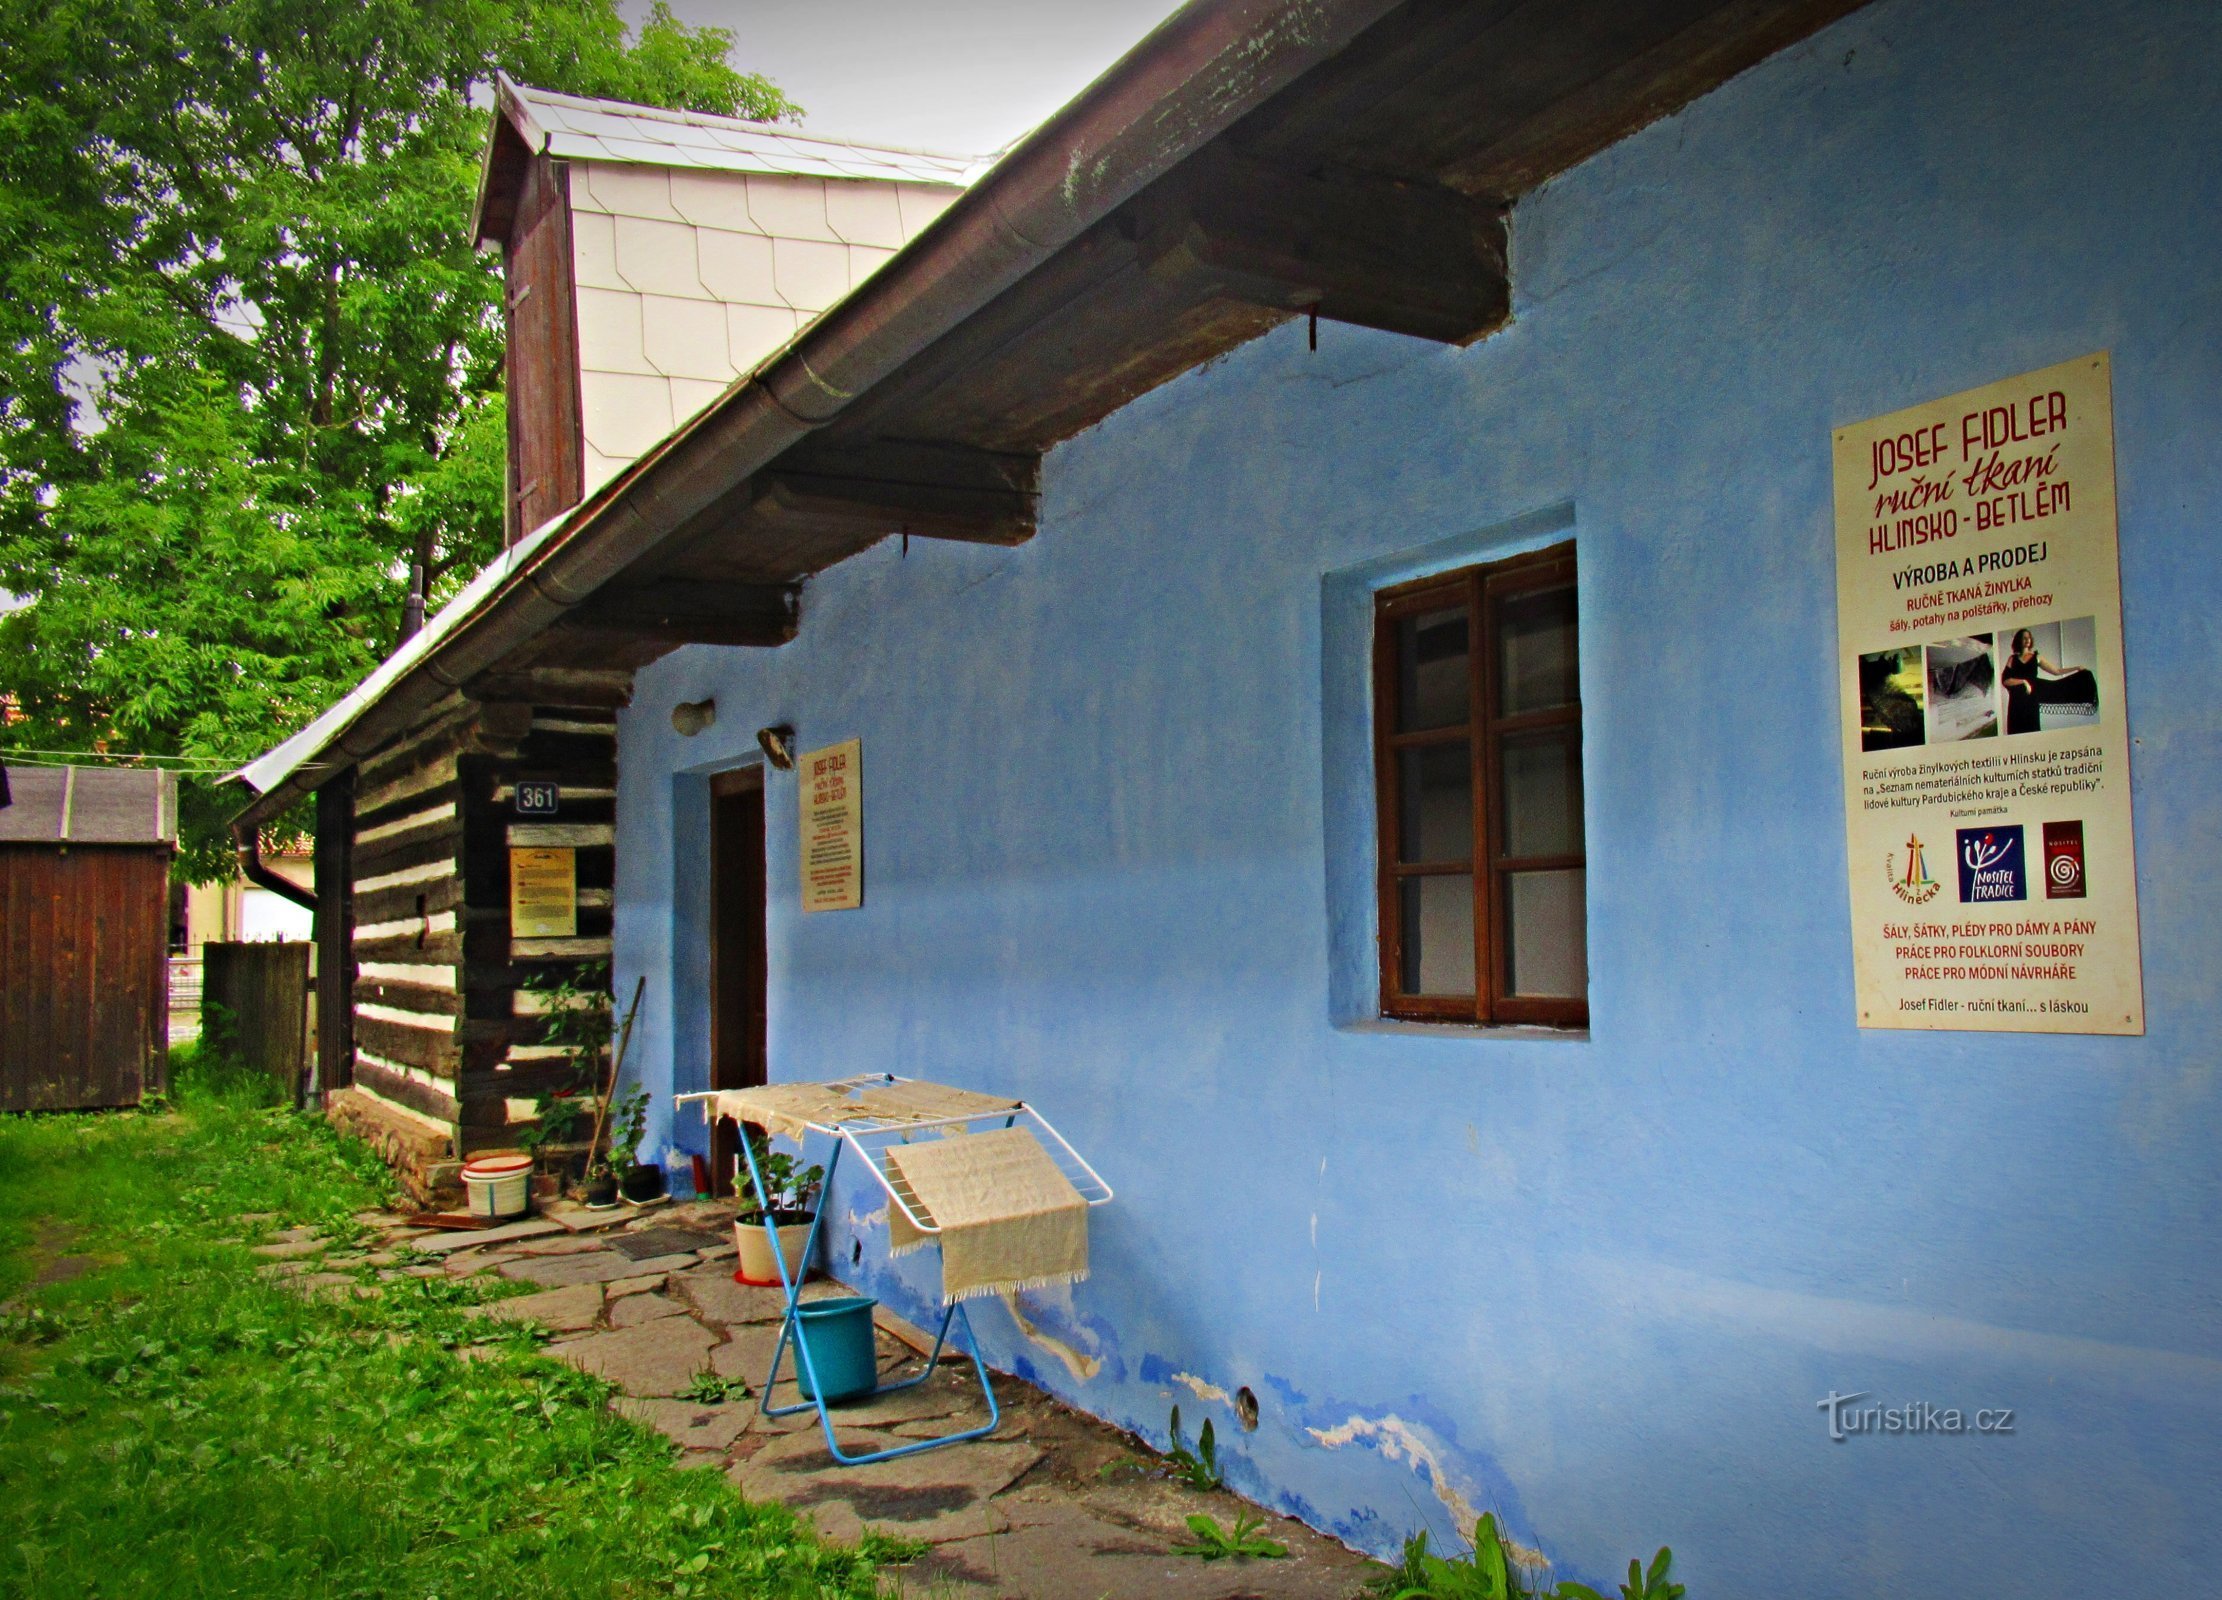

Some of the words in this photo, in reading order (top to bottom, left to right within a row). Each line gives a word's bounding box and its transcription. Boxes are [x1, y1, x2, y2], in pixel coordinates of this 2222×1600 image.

[1868, 422, 1948, 490] JOSEF
[1962, 391, 2066, 462] FIDLER
[1875, 469, 1956, 518] ruční
[1962, 443, 2061, 496] tkaní
[1869, 509, 1957, 555] HLINSKO
[1976, 481, 2070, 531] BETLÉM
[1893, 560, 1959, 590] VÝROBA
[1963, 557, 1974, 576] A
[1978, 541, 2047, 573] PRODEJ
[1907, 590, 1944, 611] RUČNĚ
[1946, 582, 1982, 604] TKANÁ
[1985, 576, 2032, 597] ŽINYLKA
[1889, 617, 1911, 632] šály,
[1913, 611, 1945, 629] potahy
[1947, 611, 1960, 621] na
[1962, 601, 2010, 621] polštářky,
[2012, 593, 2053, 612] přehozy
[1862, 768, 1887, 780] Ruční
[1889, 766, 1917, 779] výroba
[1919, 760, 1970, 775] žinylkových
[2003, 757, 2008, 765] v
[2010, 752, 2046, 765] Hlinsku
[2048, 750, 2058, 763] je
[2060, 746, 2102, 760] zapsána
[1863, 786, 1874, 795] na
[1915, 774, 1981, 790] nemateriálních
[1983, 769, 2030, 784] kulturních
[2032, 765, 2062, 778] statků
[2064, 761, 2103, 775] tradiční
[523, 787, 552, 807] 361
[1864, 798, 1889, 809] lidové
[1890, 796, 1920, 808] kultury
[1922, 789, 1984, 805] Pardubického
[1986, 788, 2009, 800] kraje
[2011, 788, 2017, 797] a
[2019, 783, 2048, 796] České
[1978, 806, 2008, 817] památka
[1977, 869, 2014, 885] NOSITEL
[1892, 882, 1941, 905] Hlinecka
[1976, 885, 2014, 900] TRADICE
[1883, 923, 1911, 940] ŠÁLY,
[1913, 922, 1949, 939] ŠÁTKY,
[1952, 921, 1987, 937] PLÉDY
[1989, 923, 2013, 936] PRO
[2016, 919, 2050, 936] DÁMY
[2053, 922, 2061, 935] A
[2064, 918, 2097, 935] PÁNY
[1896, 943, 1931, 959] PRÁCE
[1934, 946, 1957, 959] PRO
[1959, 942, 2022, 958] FOLKLORNÍ
[2025, 944, 2085, 957] SOUBORY
[1905, 964, 1940, 980] PRÁCE
[1943, 966, 1966, 979] PRO
[1968, 963, 2009, 980] MÓDNÍ
[2011, 963, 2077, 980] NÁVRHÁŘE
[1899, 998, 1927, 1011] Josef
[1928, 998, 1959, 1011] Fidler
[1967, 998, 1995, 1012] ruční
[2040, 1003, 2047, 1013] s
[2049, 1000, 2089, 1014] láskou
